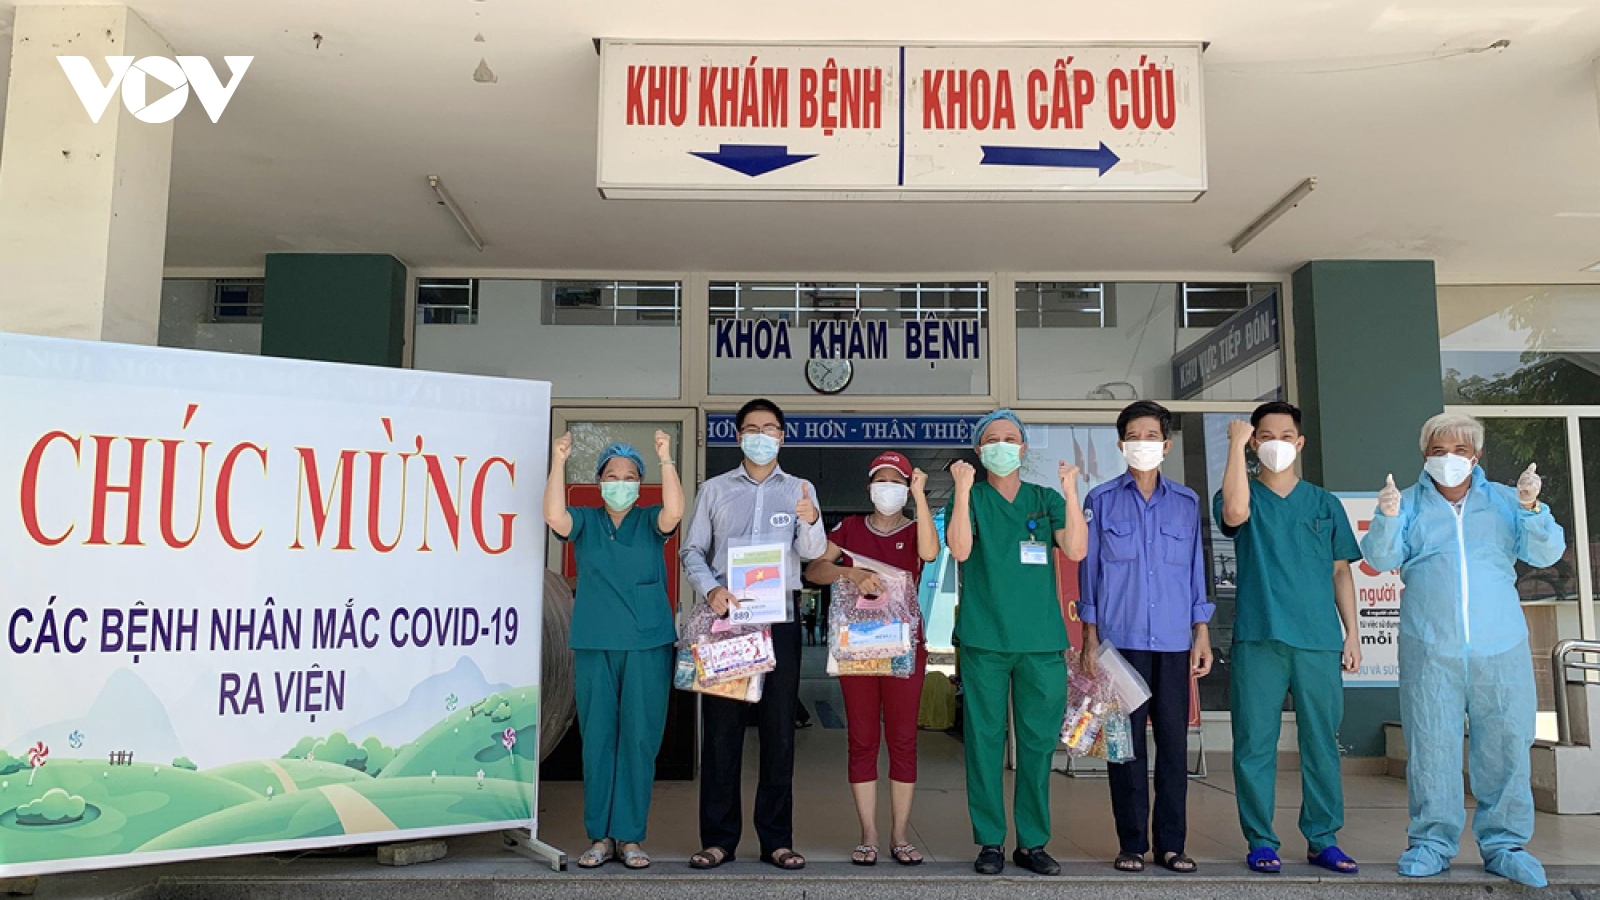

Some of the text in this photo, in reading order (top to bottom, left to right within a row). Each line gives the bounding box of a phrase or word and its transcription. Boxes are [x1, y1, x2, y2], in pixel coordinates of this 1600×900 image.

[626, 56, 882, 136] KHU KHÁM BỆNH
[923, 54, 1176, 130] KHOA CẤP CỨU
[715, 308, 980, 369] KHOA KHÁM BỆNH
[1219, 324, 1241, 365] TIẾP
[804, 419, 847, 438] HƠN
[862, 417, 917, 438] THÂN
[19, 403, 518, 555] CHÚC MỪNG
[733, 611, 750, 621] 889
[1359, 583, 1396, 607] người
[8, 595, 519, 663] CÁC BỆNH NHÂN MẮC COVID-19
[219, 664, 346, 722] RA VIỆN
[1369, 663, 1381, 675] VÀ
